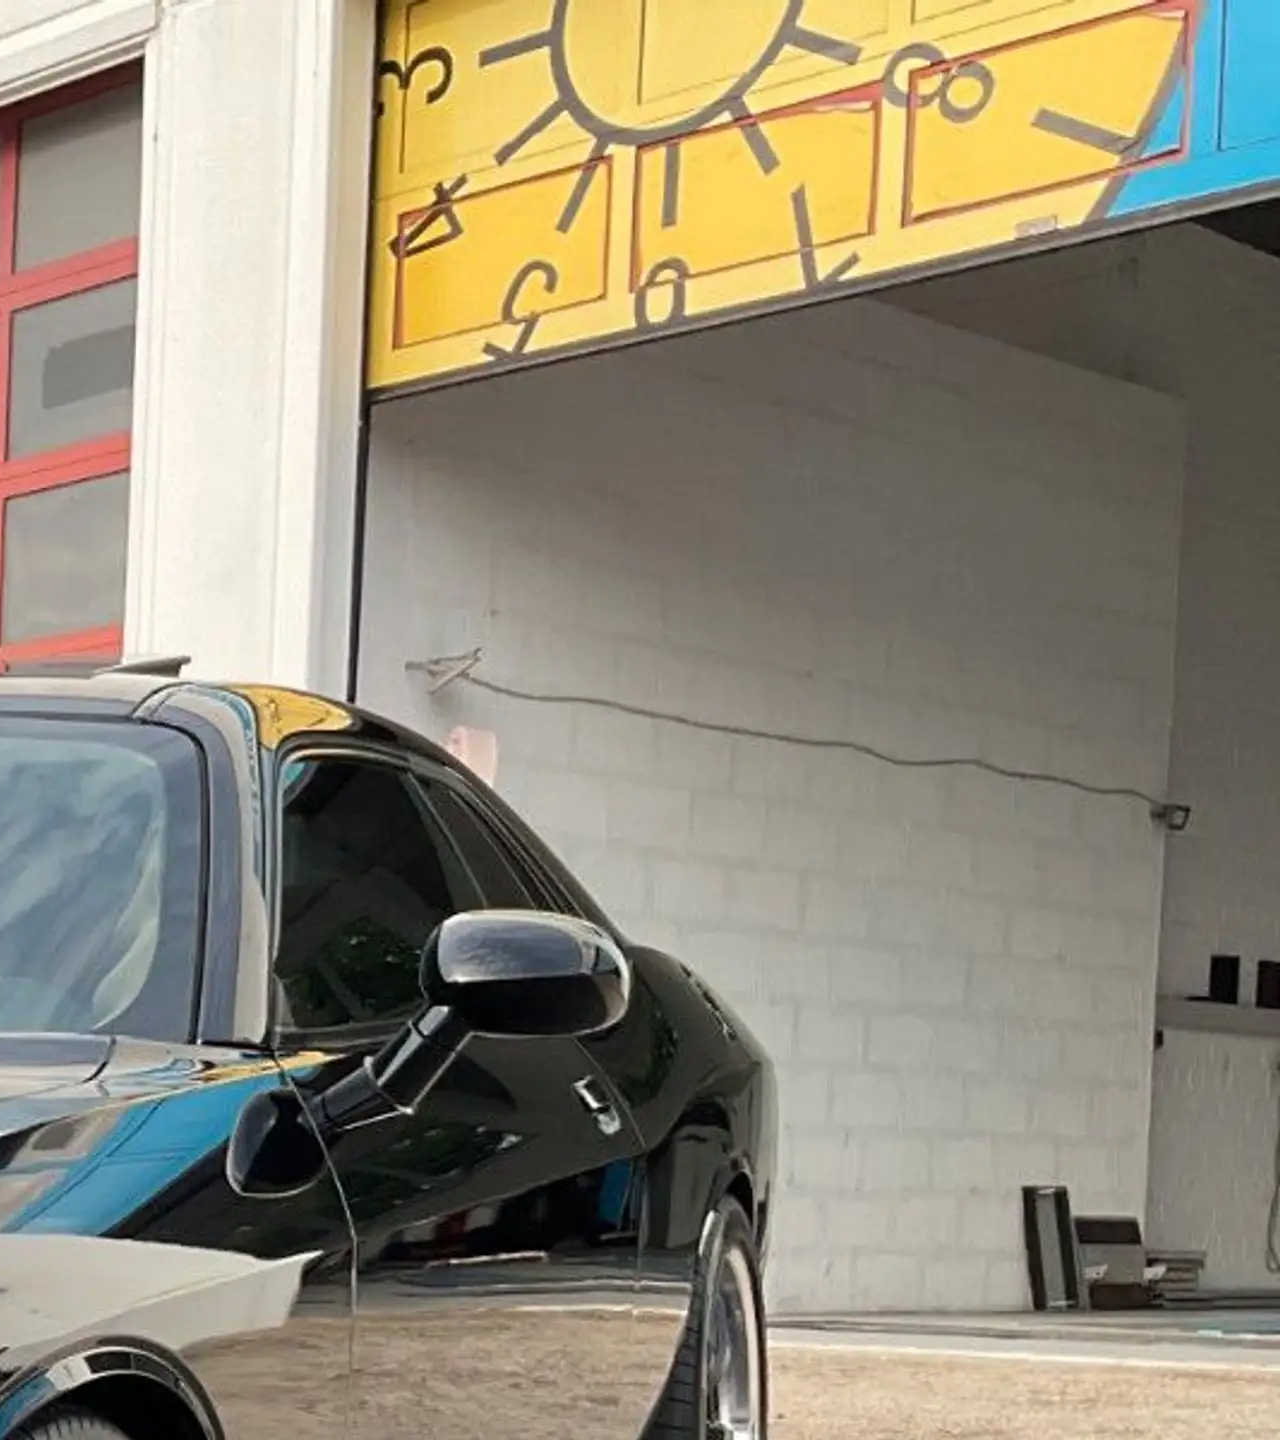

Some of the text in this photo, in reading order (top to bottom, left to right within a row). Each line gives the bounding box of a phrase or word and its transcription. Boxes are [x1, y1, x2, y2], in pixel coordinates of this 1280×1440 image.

[378, 45, 453, 105] 3
[883, 42, 995, 124] 8
[388, 173, 469, 260] 4
